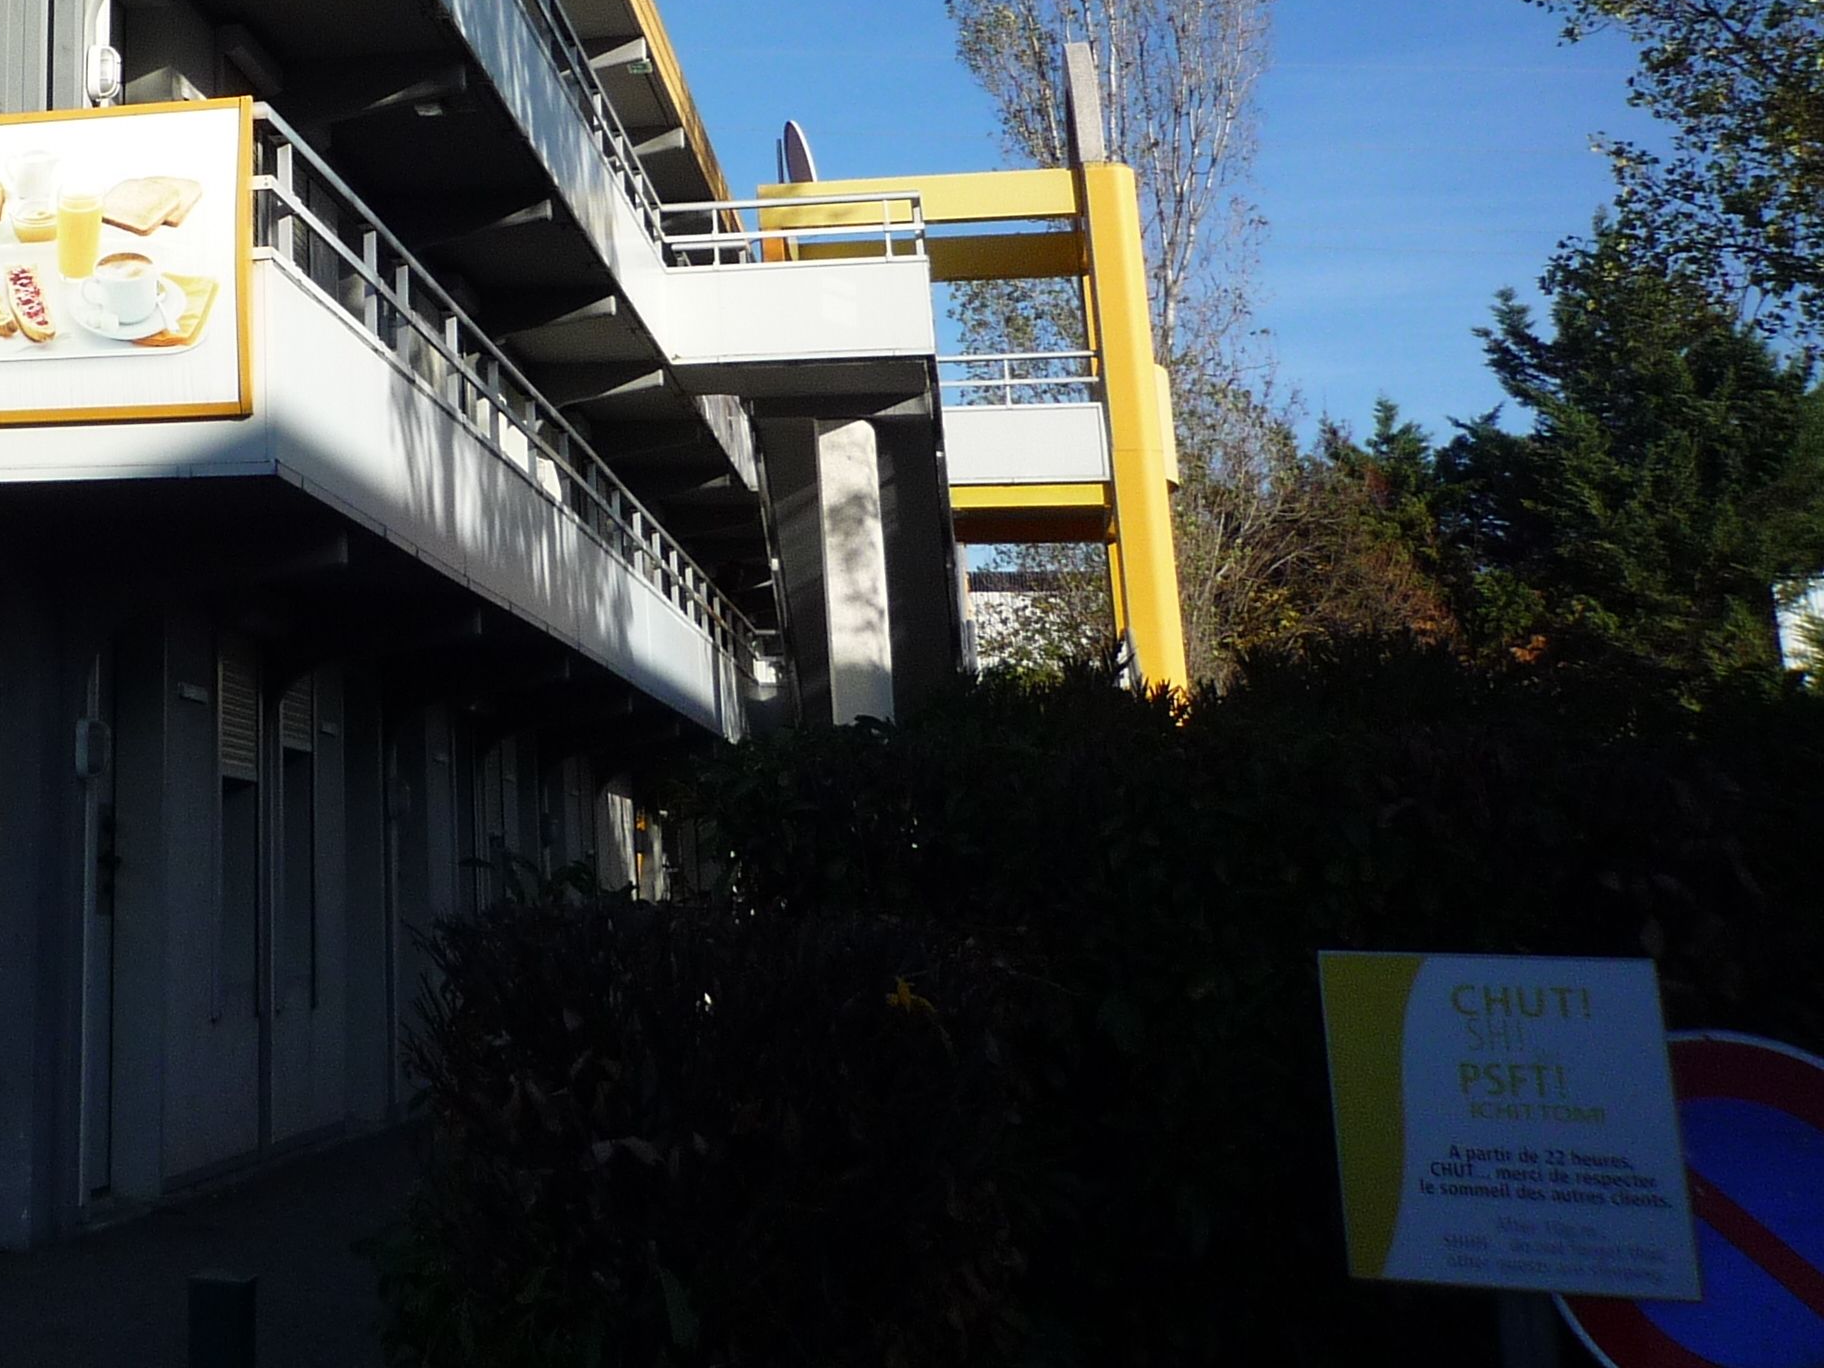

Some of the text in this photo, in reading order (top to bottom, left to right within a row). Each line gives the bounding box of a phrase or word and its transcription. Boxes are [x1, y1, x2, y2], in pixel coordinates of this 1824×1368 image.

[1450, 983, 1593, 1019] CHUT!
[1457, 1060, 1568, 1099] PSFT!
[1466, 1147, 1512, 1164] partir
[1518, 1146, 1539, 1163] de
[1544, 1149, 1565, 1166] 22
[1496, 1166, 1543, 1184] merci
[1549, 1168, 1569, 1185] de
[1419, 1177, 1434, 1195] le
[1440, 1180, 1512, 1199] sommeil
[1518, 1183, 1546, 1202] des
